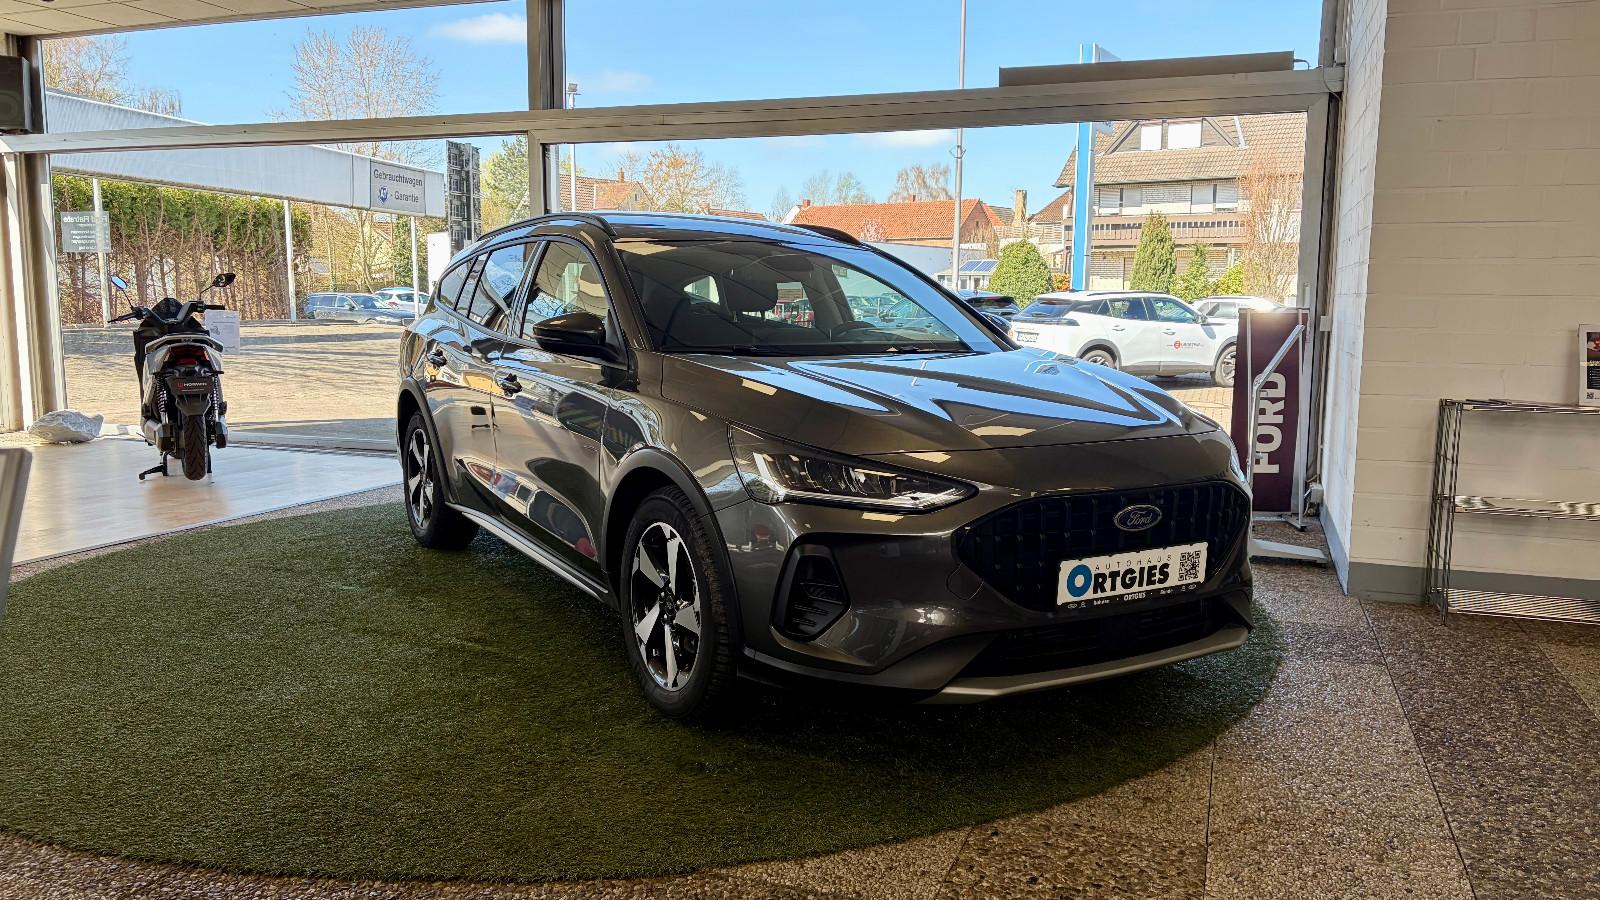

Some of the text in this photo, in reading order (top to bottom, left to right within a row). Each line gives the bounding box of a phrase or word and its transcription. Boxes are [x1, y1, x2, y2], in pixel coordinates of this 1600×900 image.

[373, 168, 423, 188] Gebrauchtwagen
[394, 190, 419, 203] Garantie
[1252, 371, 1287, 474] FORD
[1127, 510, 1153, 526] Ford
[1094, 553, 1172, 572] AUTOHAUS
[1066, 562, 1170, 598] ORTGIES
[1123, 591, 1147, 602] ORTGIES
